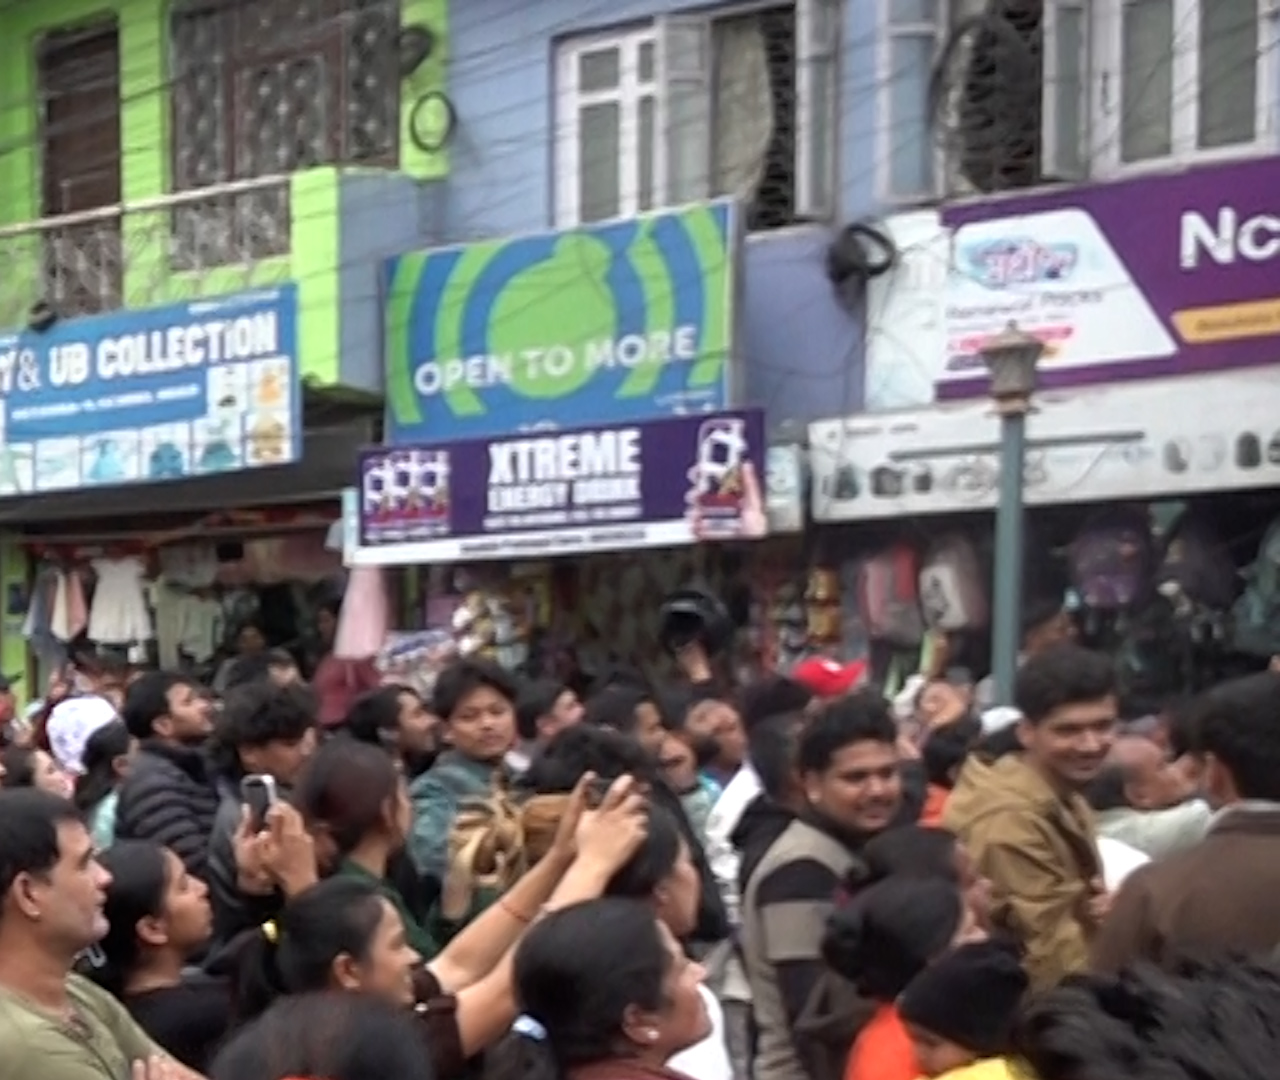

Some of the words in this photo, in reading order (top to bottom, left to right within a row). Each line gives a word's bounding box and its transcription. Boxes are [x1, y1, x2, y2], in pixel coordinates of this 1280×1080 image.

[16, 350, 41, 392] &
[49, 342, 89, 387] UB
[97, 311, 278, 380] COLLECTION
[413, 352, 513, 397] OPEN
[525, 345, 574, 381] TO
[585, 325, 698, 379] MORE
[489, 428, 641, 484] XTREME
